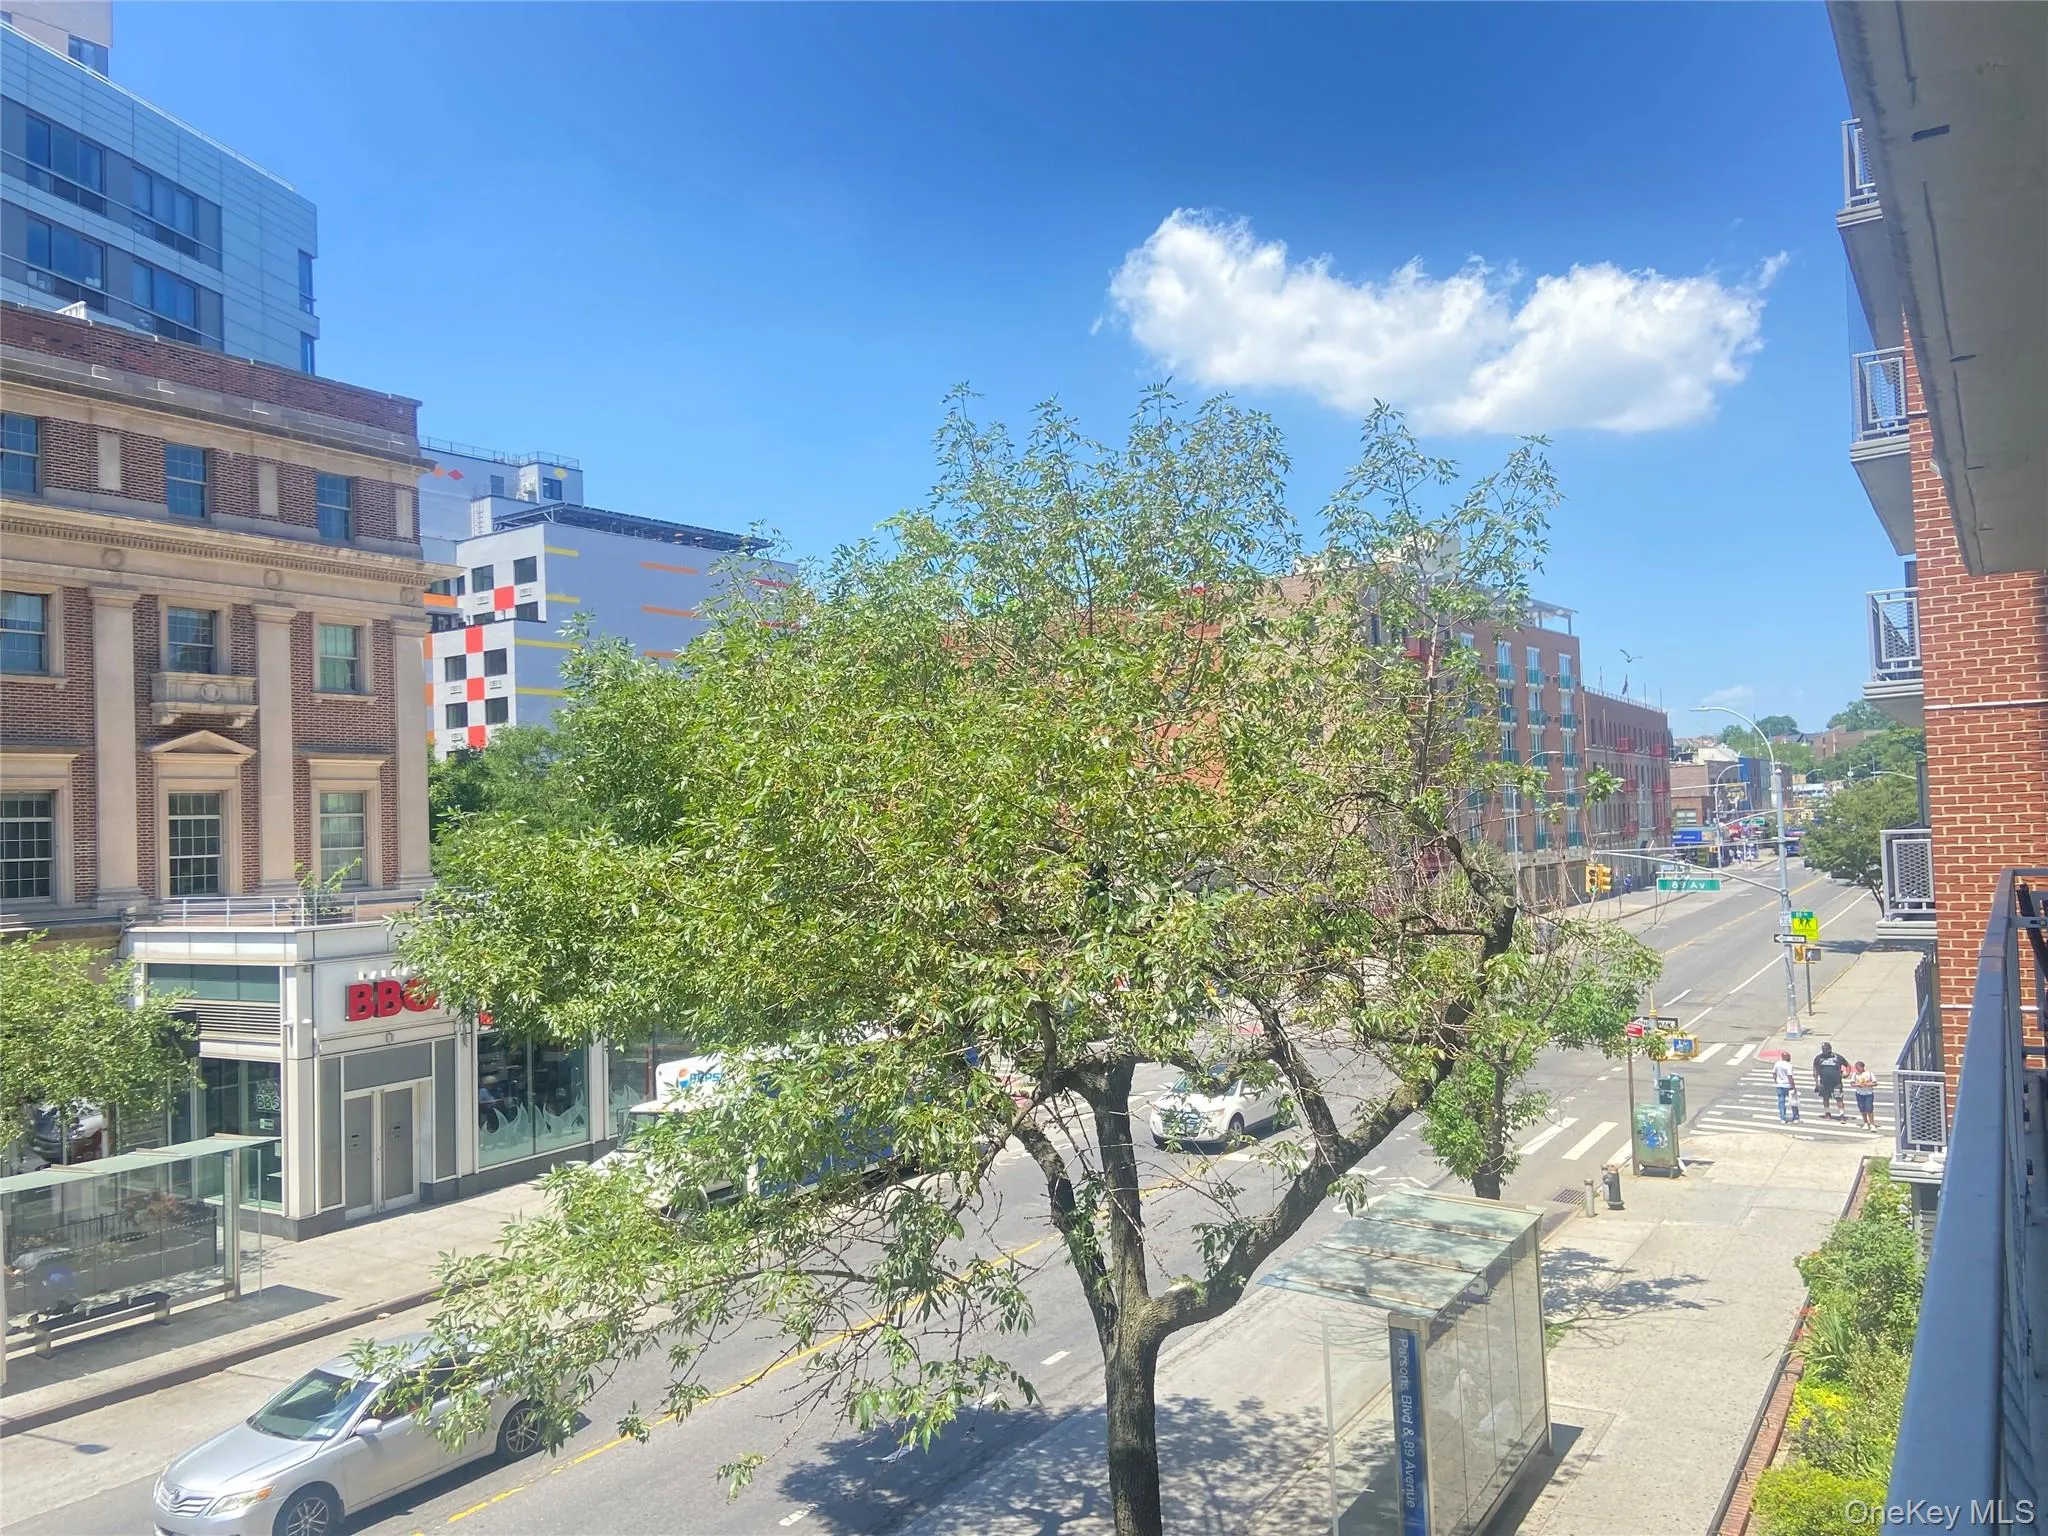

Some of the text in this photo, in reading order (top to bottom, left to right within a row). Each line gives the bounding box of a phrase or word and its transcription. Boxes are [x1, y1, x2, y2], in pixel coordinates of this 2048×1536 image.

[1397, 1338, 1416, 1509] Parsons Blvd & 89 Avenue
